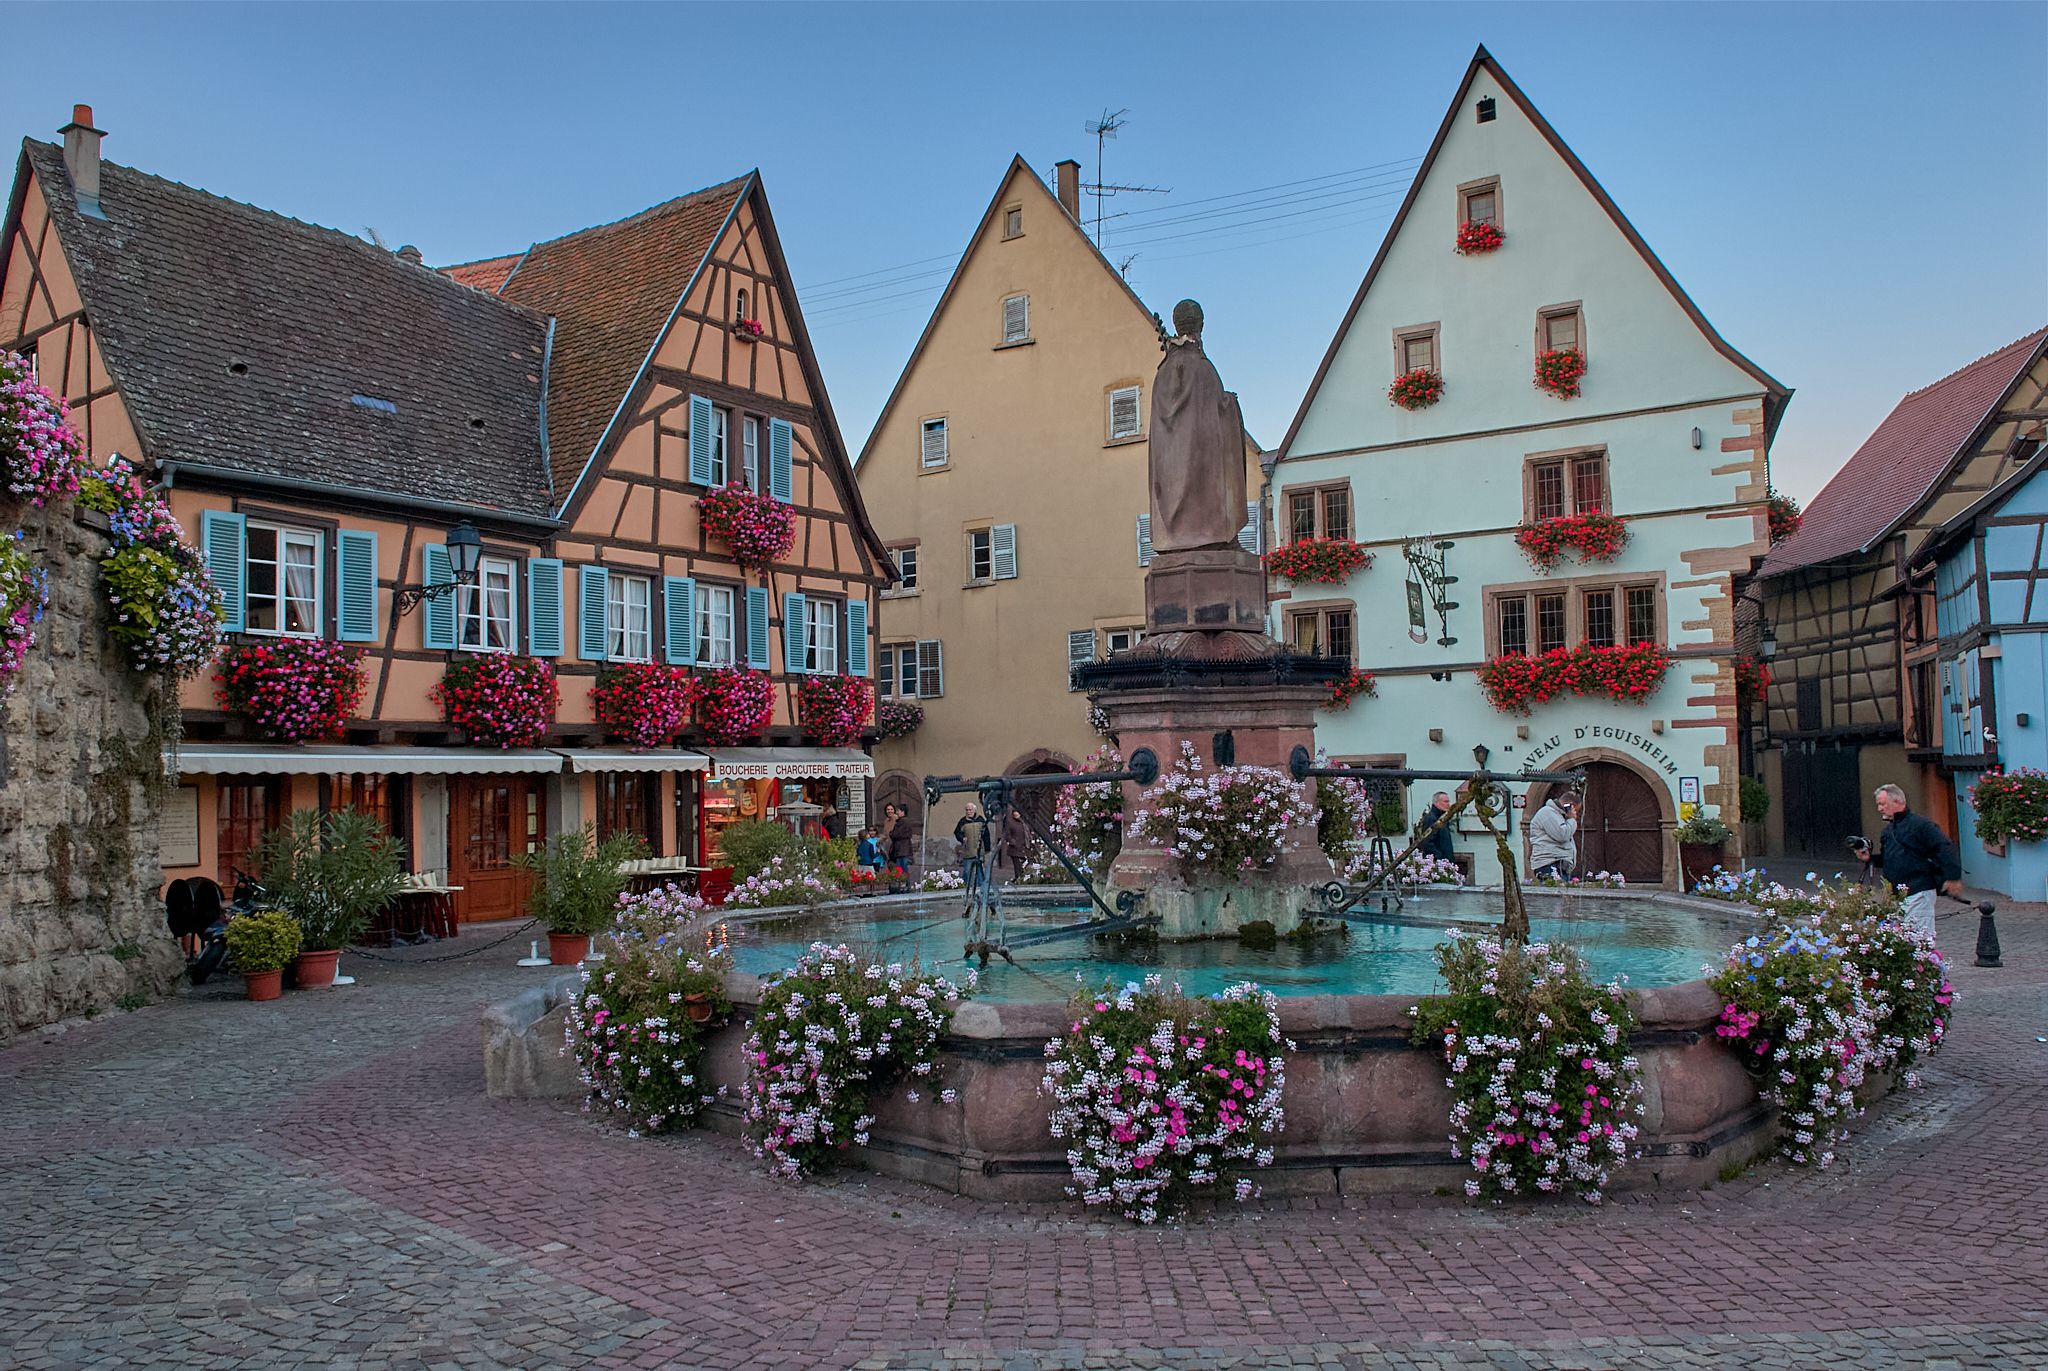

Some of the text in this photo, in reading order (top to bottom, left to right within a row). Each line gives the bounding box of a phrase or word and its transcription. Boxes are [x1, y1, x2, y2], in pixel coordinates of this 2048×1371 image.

[719, 763, 870, 775] BOUCHERIE CHARCUTERIE TRAITEUR
